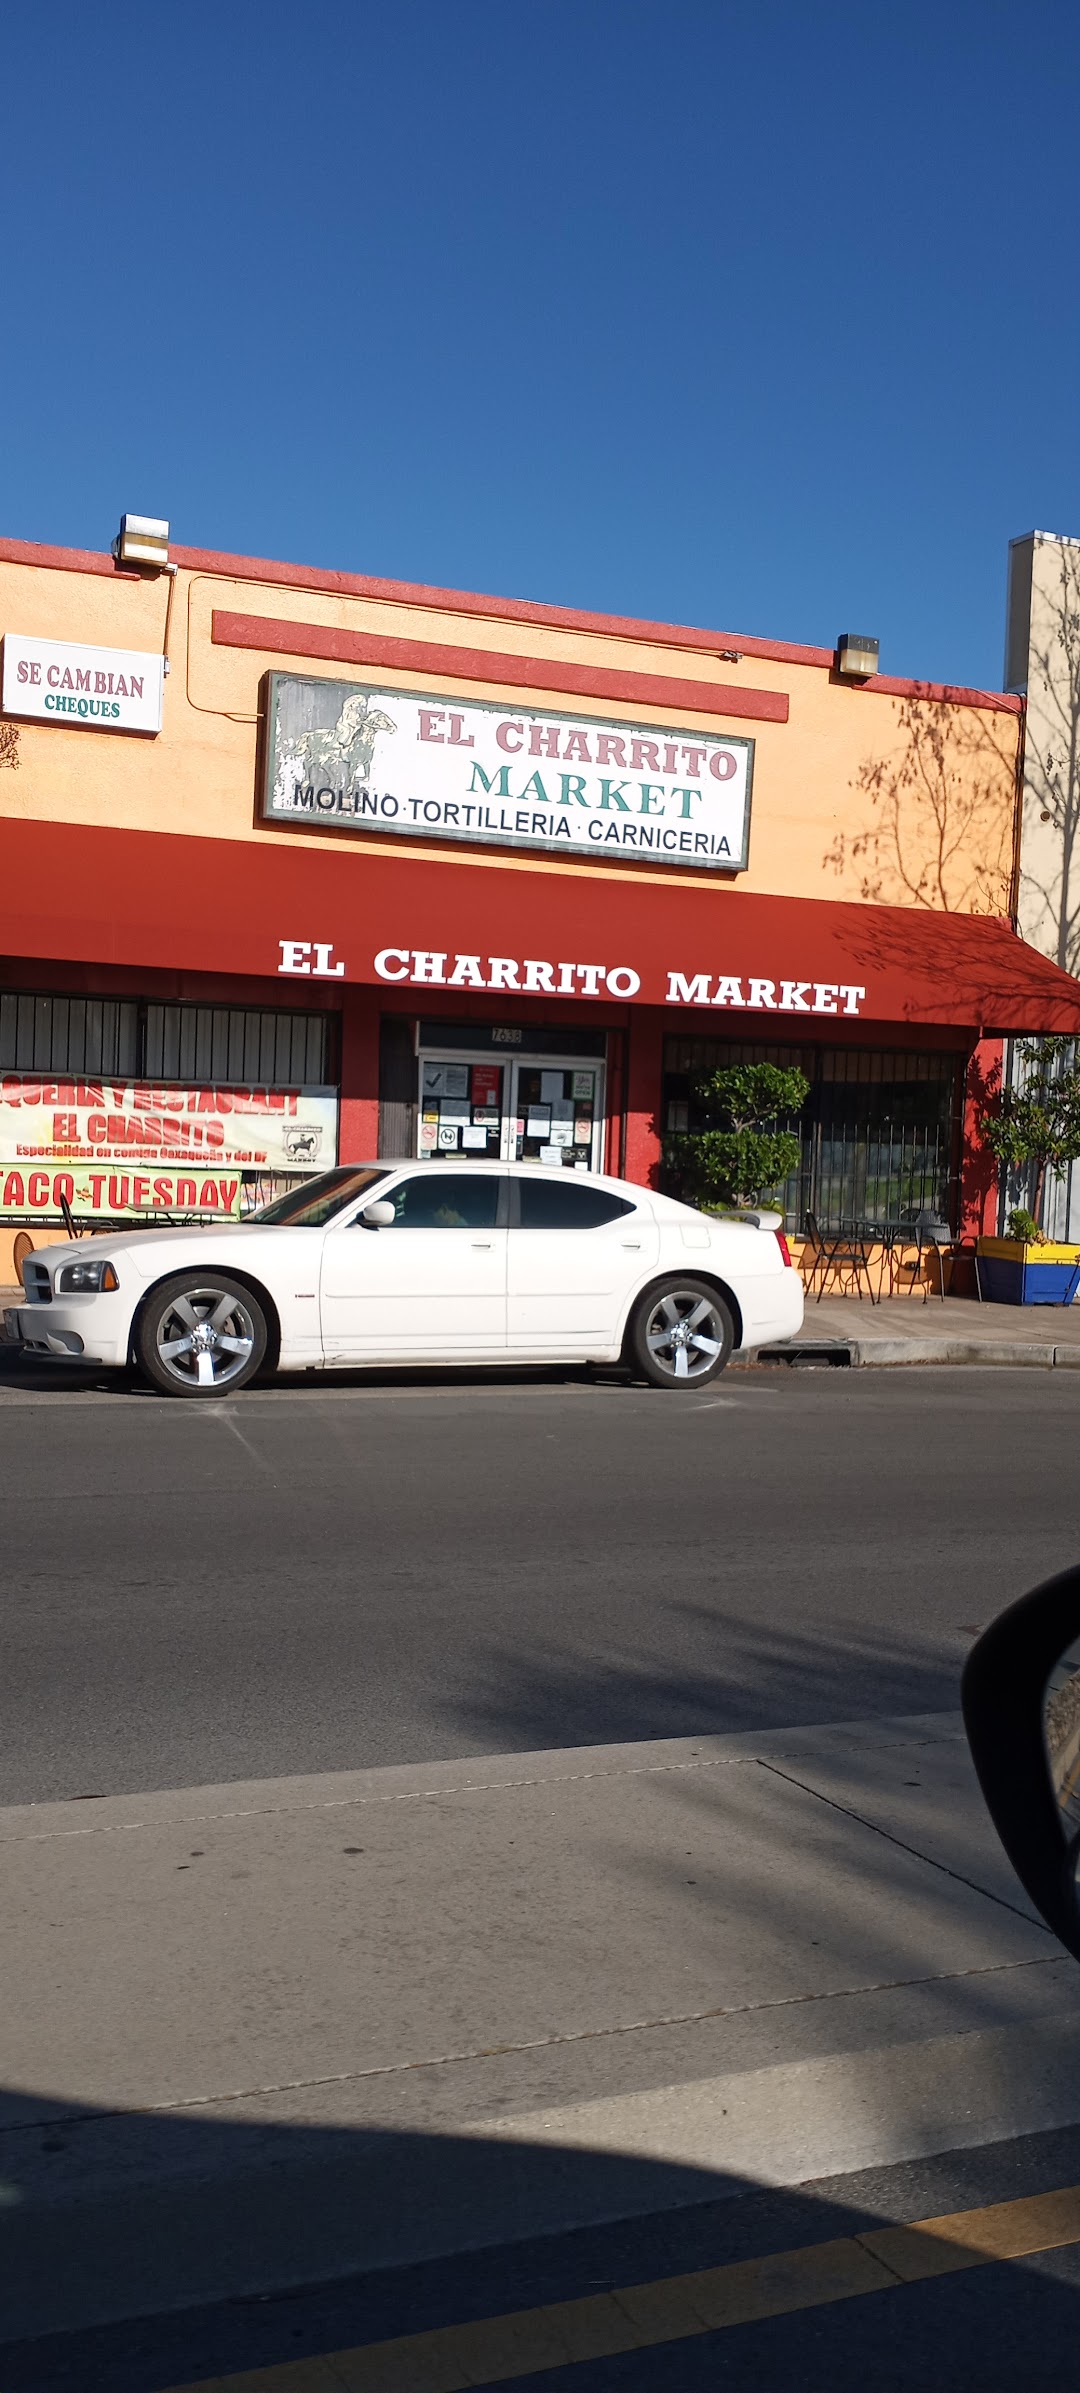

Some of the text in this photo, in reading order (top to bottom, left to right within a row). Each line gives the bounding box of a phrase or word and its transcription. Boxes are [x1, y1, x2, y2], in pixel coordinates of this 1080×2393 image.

[17, 660, 144, 699] SE CAMBIAN
[45, 694, 120, 717] CHEQUES
[417, 709, 738, 781] EL CHARRITO
[465, 761, 702, 819] MARKET
[294, 784, 731, 856] MOLINO TORTILLERIA CARNICERIA
[278, 940, 866, 1014] EL CHARRITO MARKET
[493, 1028, 521, 1042] 7638
[0, 1074, 301, 1116] QUERIA Y RESTAURANT
[53, 1113, 225, 1148] EL CHARRITO
[16, 1144, 94, 1157] Especialidad
[97, 1148, 111, 1157] en
[234, 1151, 252, 1161] del
[0, 1171, 238, 1214] ACO TUESDAY
